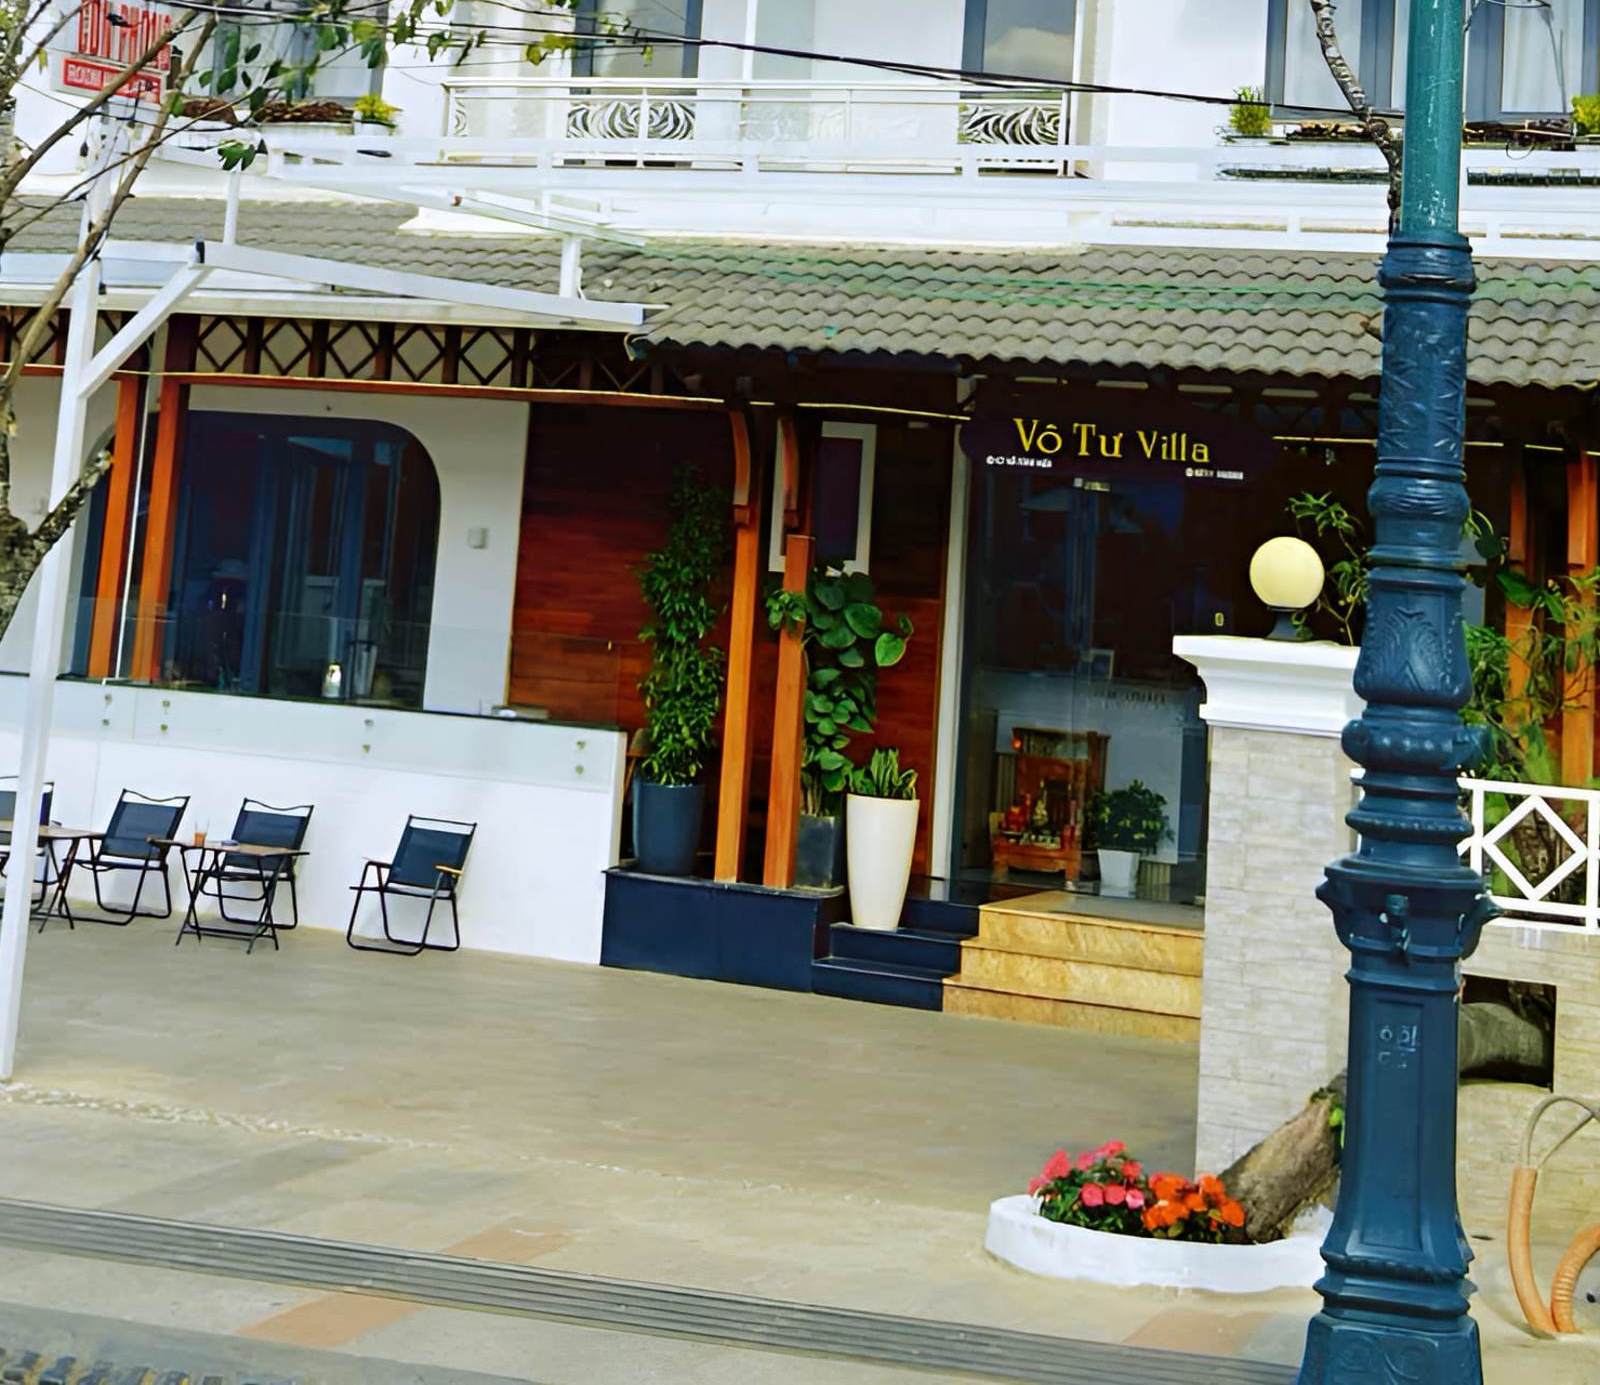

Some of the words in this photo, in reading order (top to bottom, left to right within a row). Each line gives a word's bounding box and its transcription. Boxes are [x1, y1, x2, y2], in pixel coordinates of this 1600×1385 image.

[1013, 418, 1063, 454] Vô
[1072, 423, 1124, 458] Tư
[1136, 430, 1210, 463] Villa
